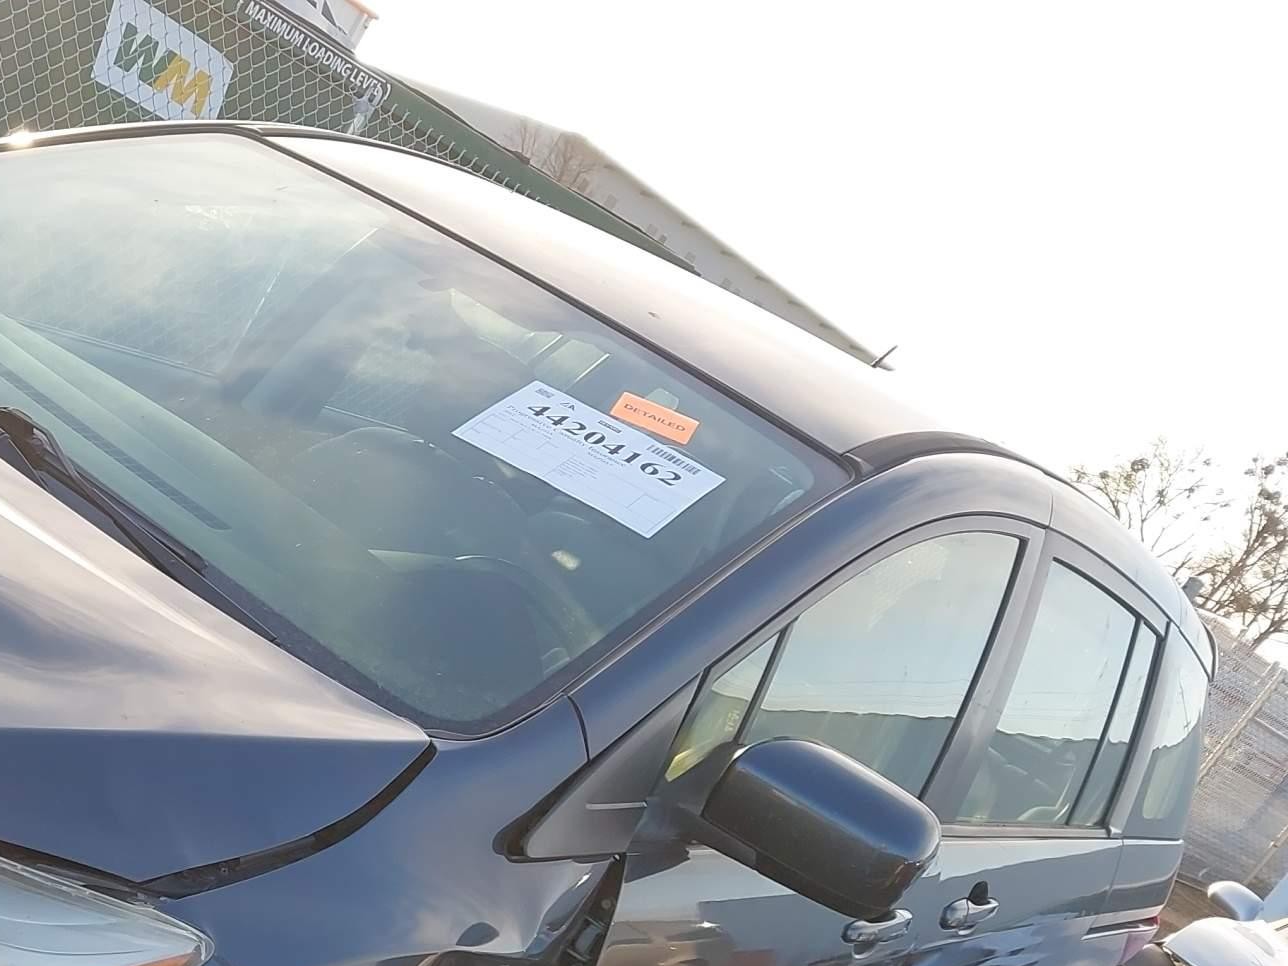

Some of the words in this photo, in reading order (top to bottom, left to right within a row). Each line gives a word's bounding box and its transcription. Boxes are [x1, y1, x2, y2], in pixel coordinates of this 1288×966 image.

[113, 23, 213, 118] WM
[245, 1, 305, 47] MAXIMUM
[302, 37, 353, 77] LOADING
[528, 405, 682, 487] 44204162
[623, 403, 686, 432] DETAILED
